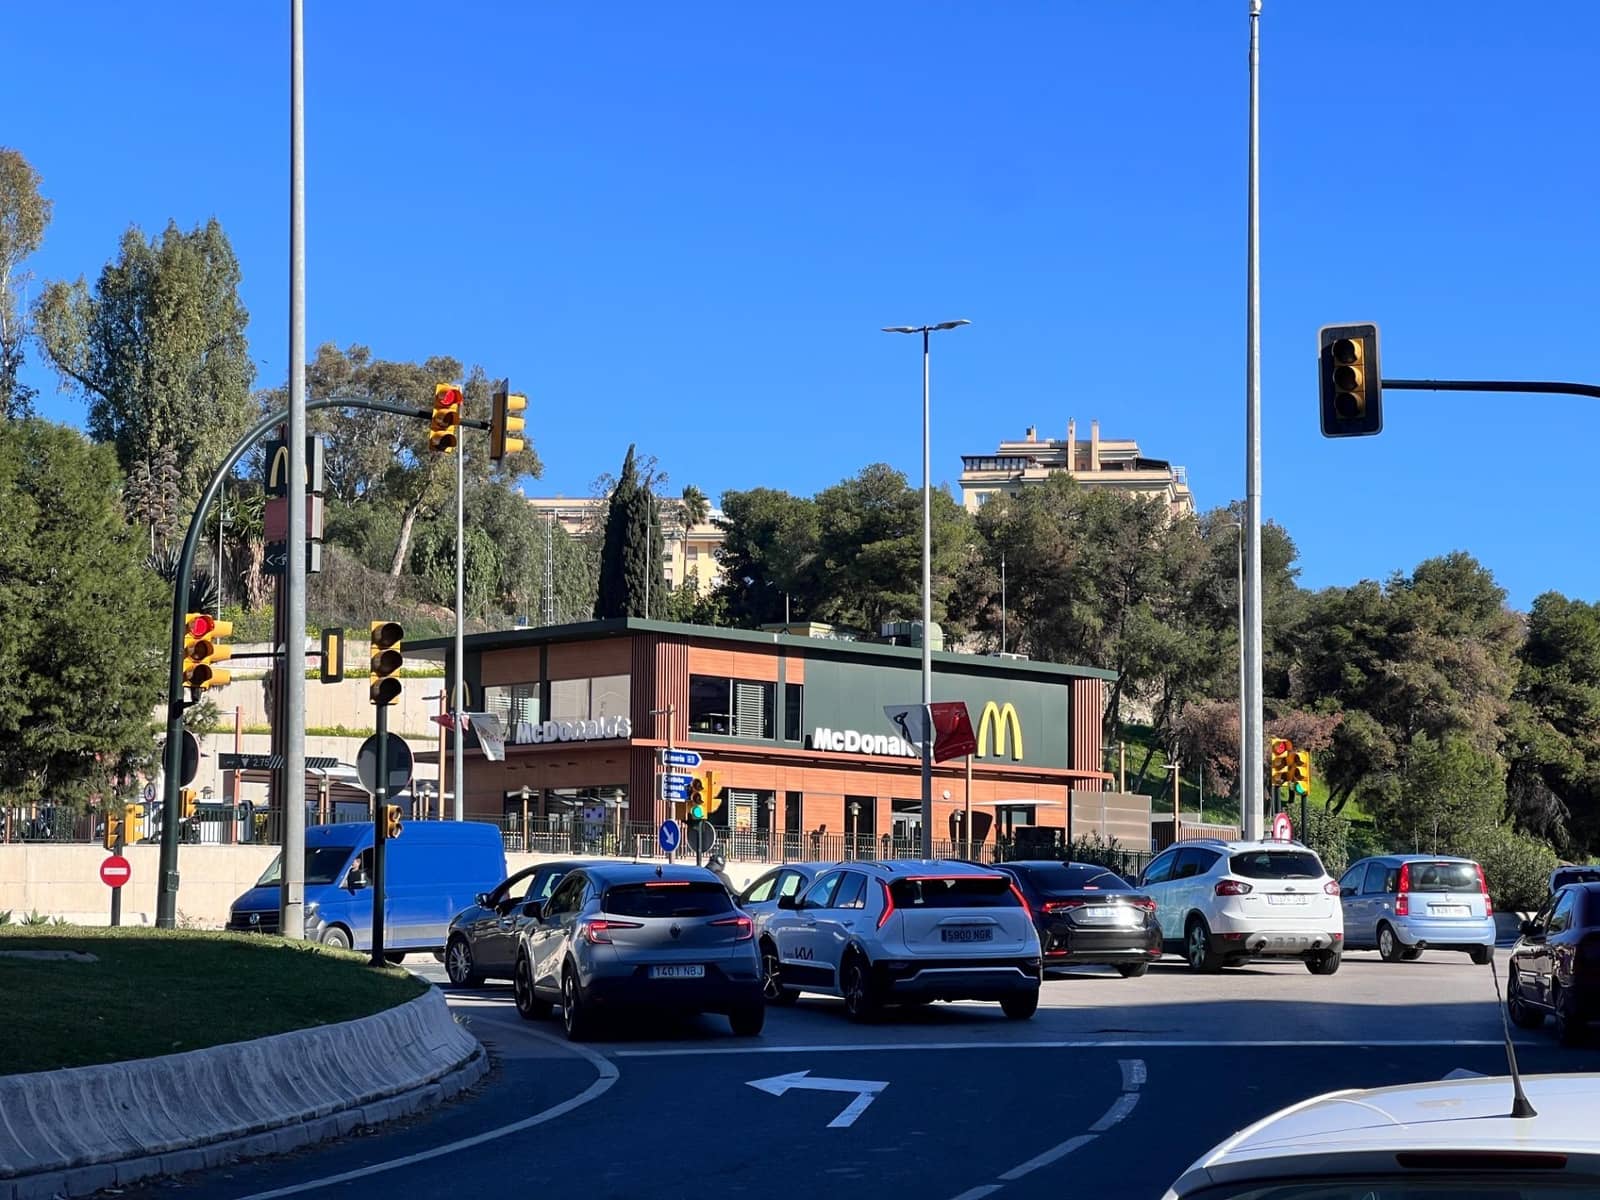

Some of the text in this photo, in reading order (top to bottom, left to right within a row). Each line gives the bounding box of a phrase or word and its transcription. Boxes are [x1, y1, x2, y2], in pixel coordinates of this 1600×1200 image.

[515, 715, 632, 744] McDonald's
[655, 965, 703, 977] 1401 NBJ
